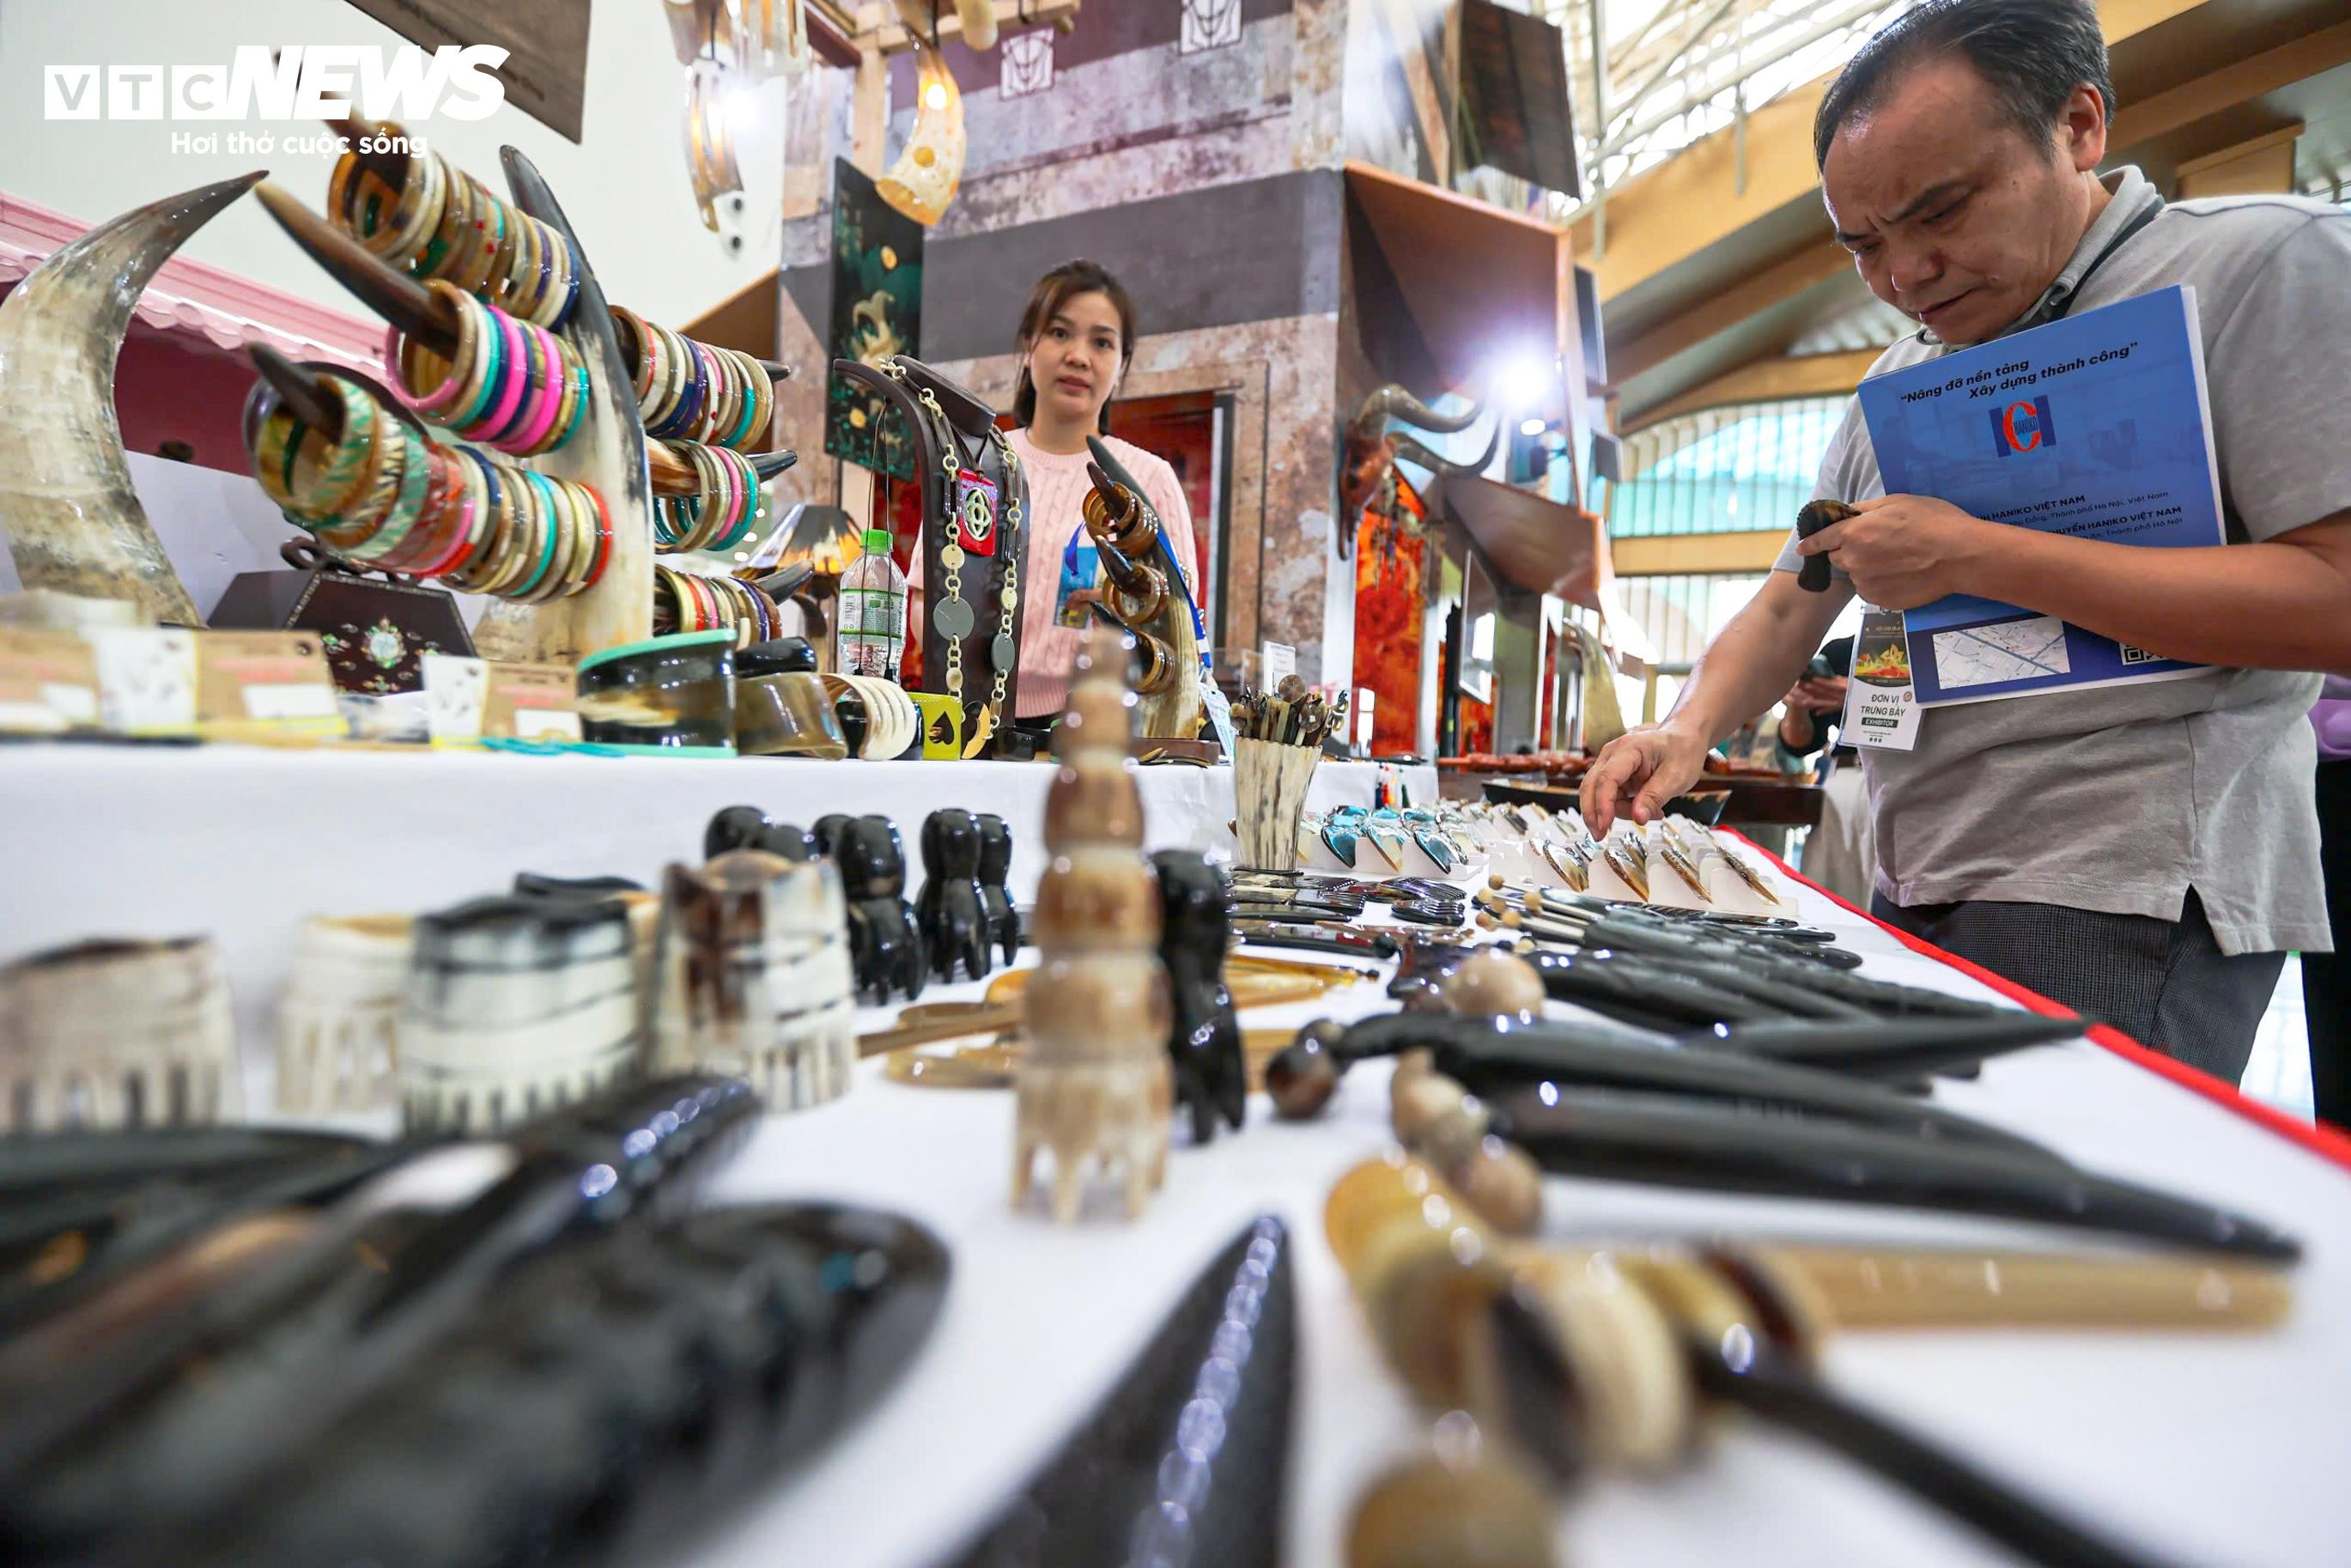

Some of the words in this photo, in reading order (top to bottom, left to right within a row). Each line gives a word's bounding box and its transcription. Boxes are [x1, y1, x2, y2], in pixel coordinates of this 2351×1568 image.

[1946, 378, 1963, 391] đỡ
[1996, 360, 2029, 376] tảng
[1969, 384, 1996, 398] Xây
[2000, 373, 2037, 390] dựng
[2041, 357, 2085, 379] thành
[2147, 492, 2169, 501] Nam
[1992, 507, 2032, 520] HANIKO
[2033, 501, 2057, 512] VIỆT
[2060, 495, 2086, 507] NAM
[2087, 517, 2128, 530] HANIKO
[2130, 510, 2154, 523] VIỆT
[2156, 507, 2182, 517] NAM
[1871, 694, 1890, 702] ĐƠN
[1891, 696, 1900, 705] VỊ
[1861, 705, 1888, 715] TRƯNG
[1865, 719, 1894, 727] EXHIBITOR
